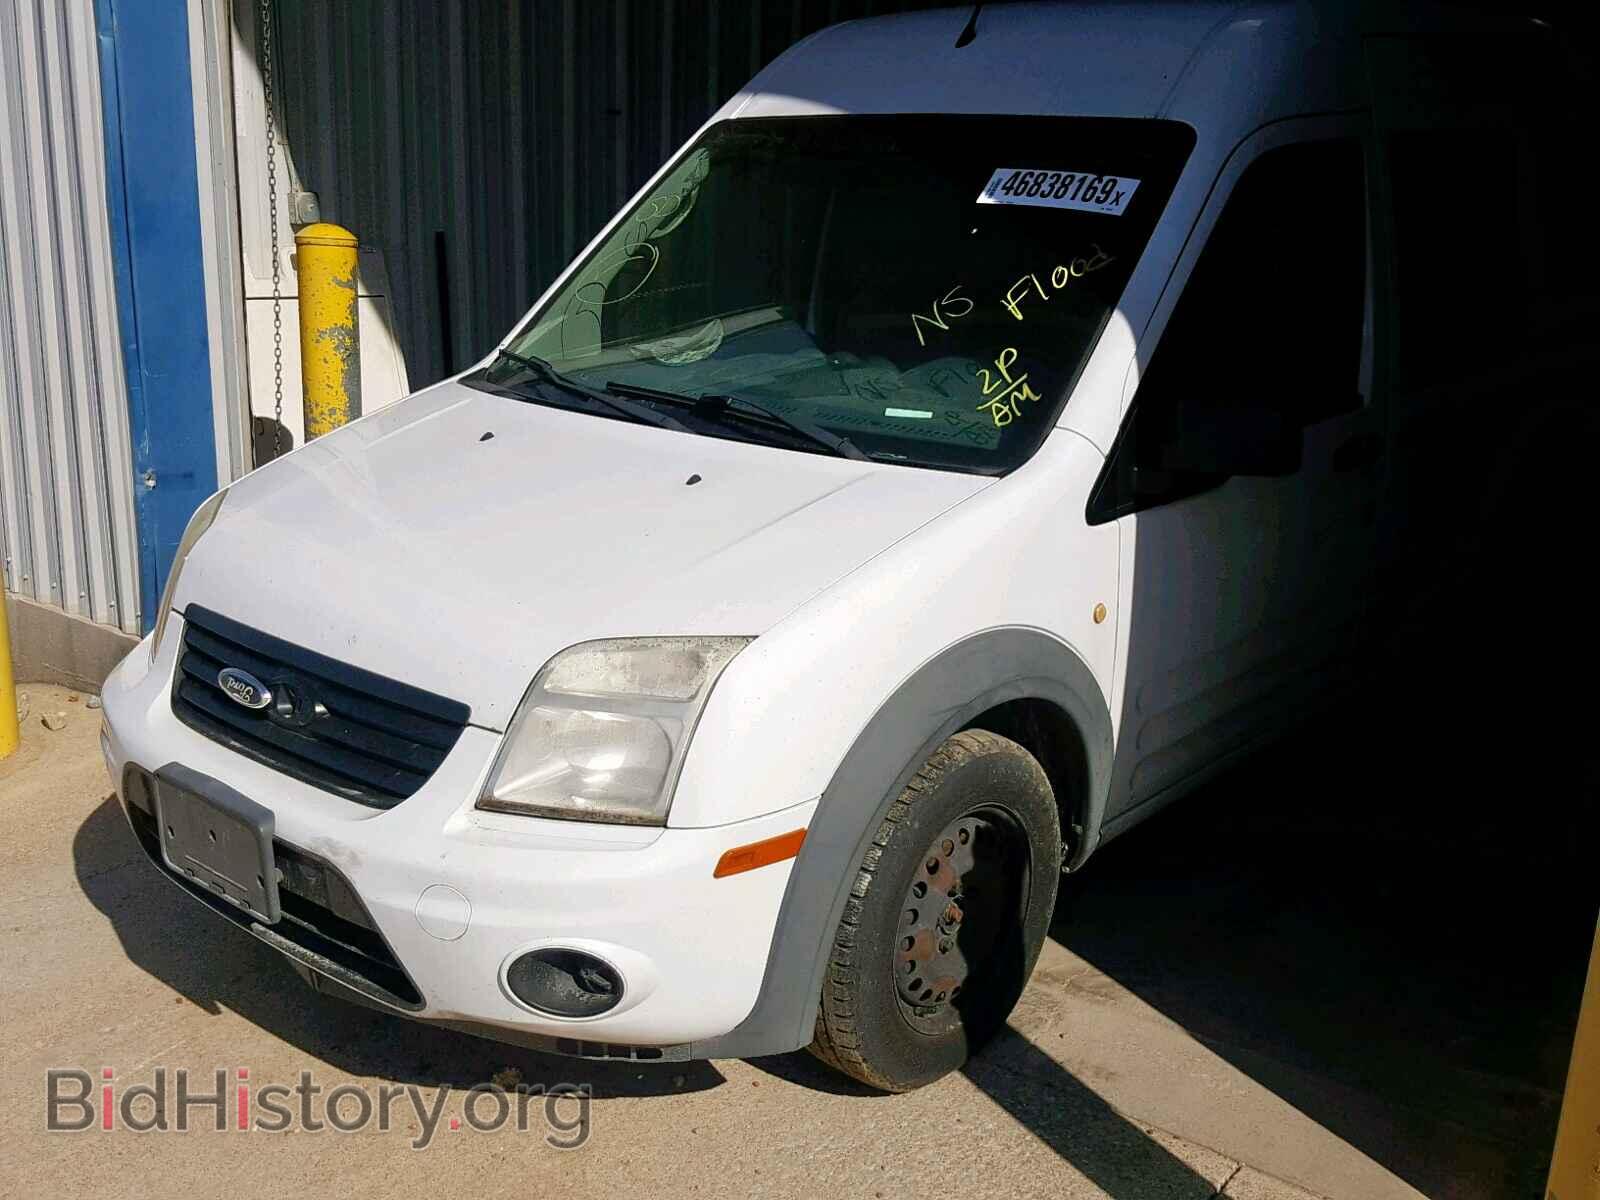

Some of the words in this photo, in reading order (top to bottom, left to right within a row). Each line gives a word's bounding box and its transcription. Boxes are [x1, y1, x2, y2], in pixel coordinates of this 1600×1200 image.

[912, 286, 973, 345] NS
[977, 348, 1018, 394] 2P
[226, 677, 253, 702] Ford
